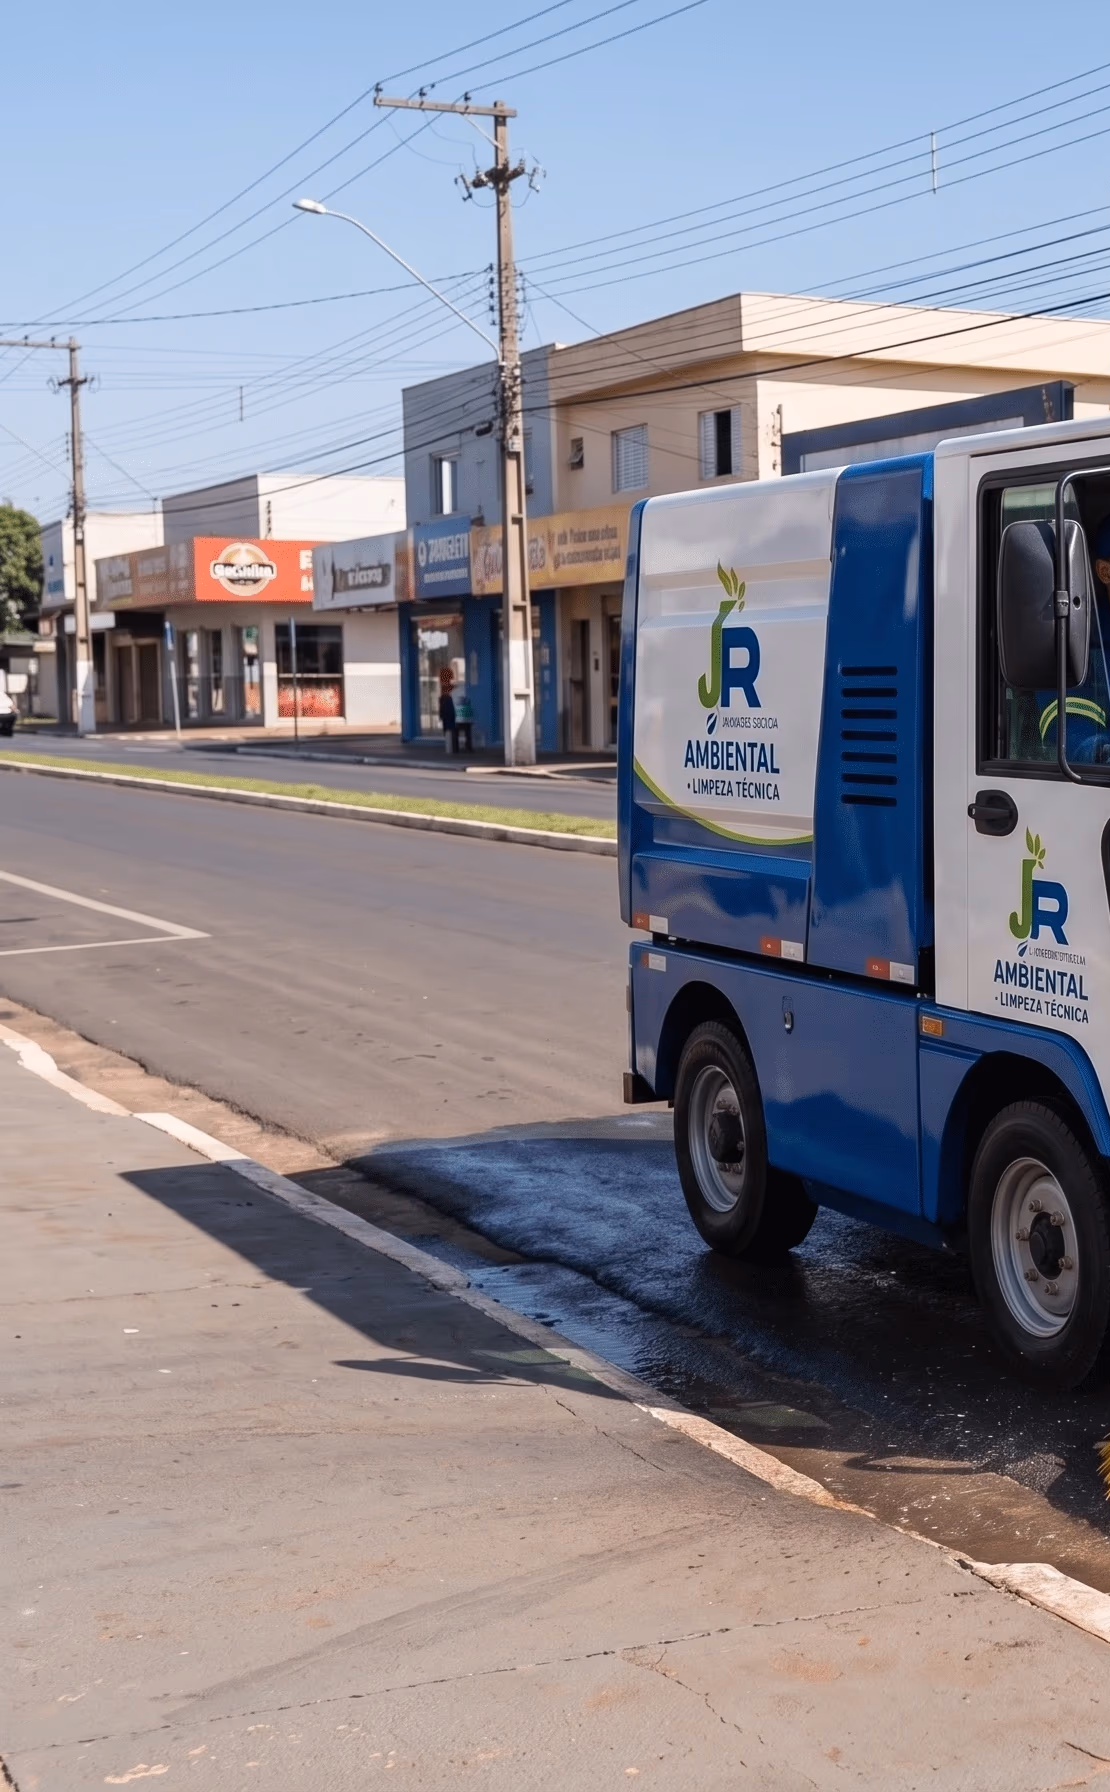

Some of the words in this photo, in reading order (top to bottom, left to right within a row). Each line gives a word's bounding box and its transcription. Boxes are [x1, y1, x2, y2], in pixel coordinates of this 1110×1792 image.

[698, 600, 761, 709] JR
[684, 740, 780, 774] AMBIENTAL
[692, 778, 733, 797] LIMPEZA
[736, 777, 780, 801] TÉCNICA
[1009, 859, 1069, 945] JR
[994, 959, 1089, 1001] AMBIENTAL
[1000, 992, 1042, 1014] LIMPEZA
[1044, 999, 1089, 1023] TÉCNICA
